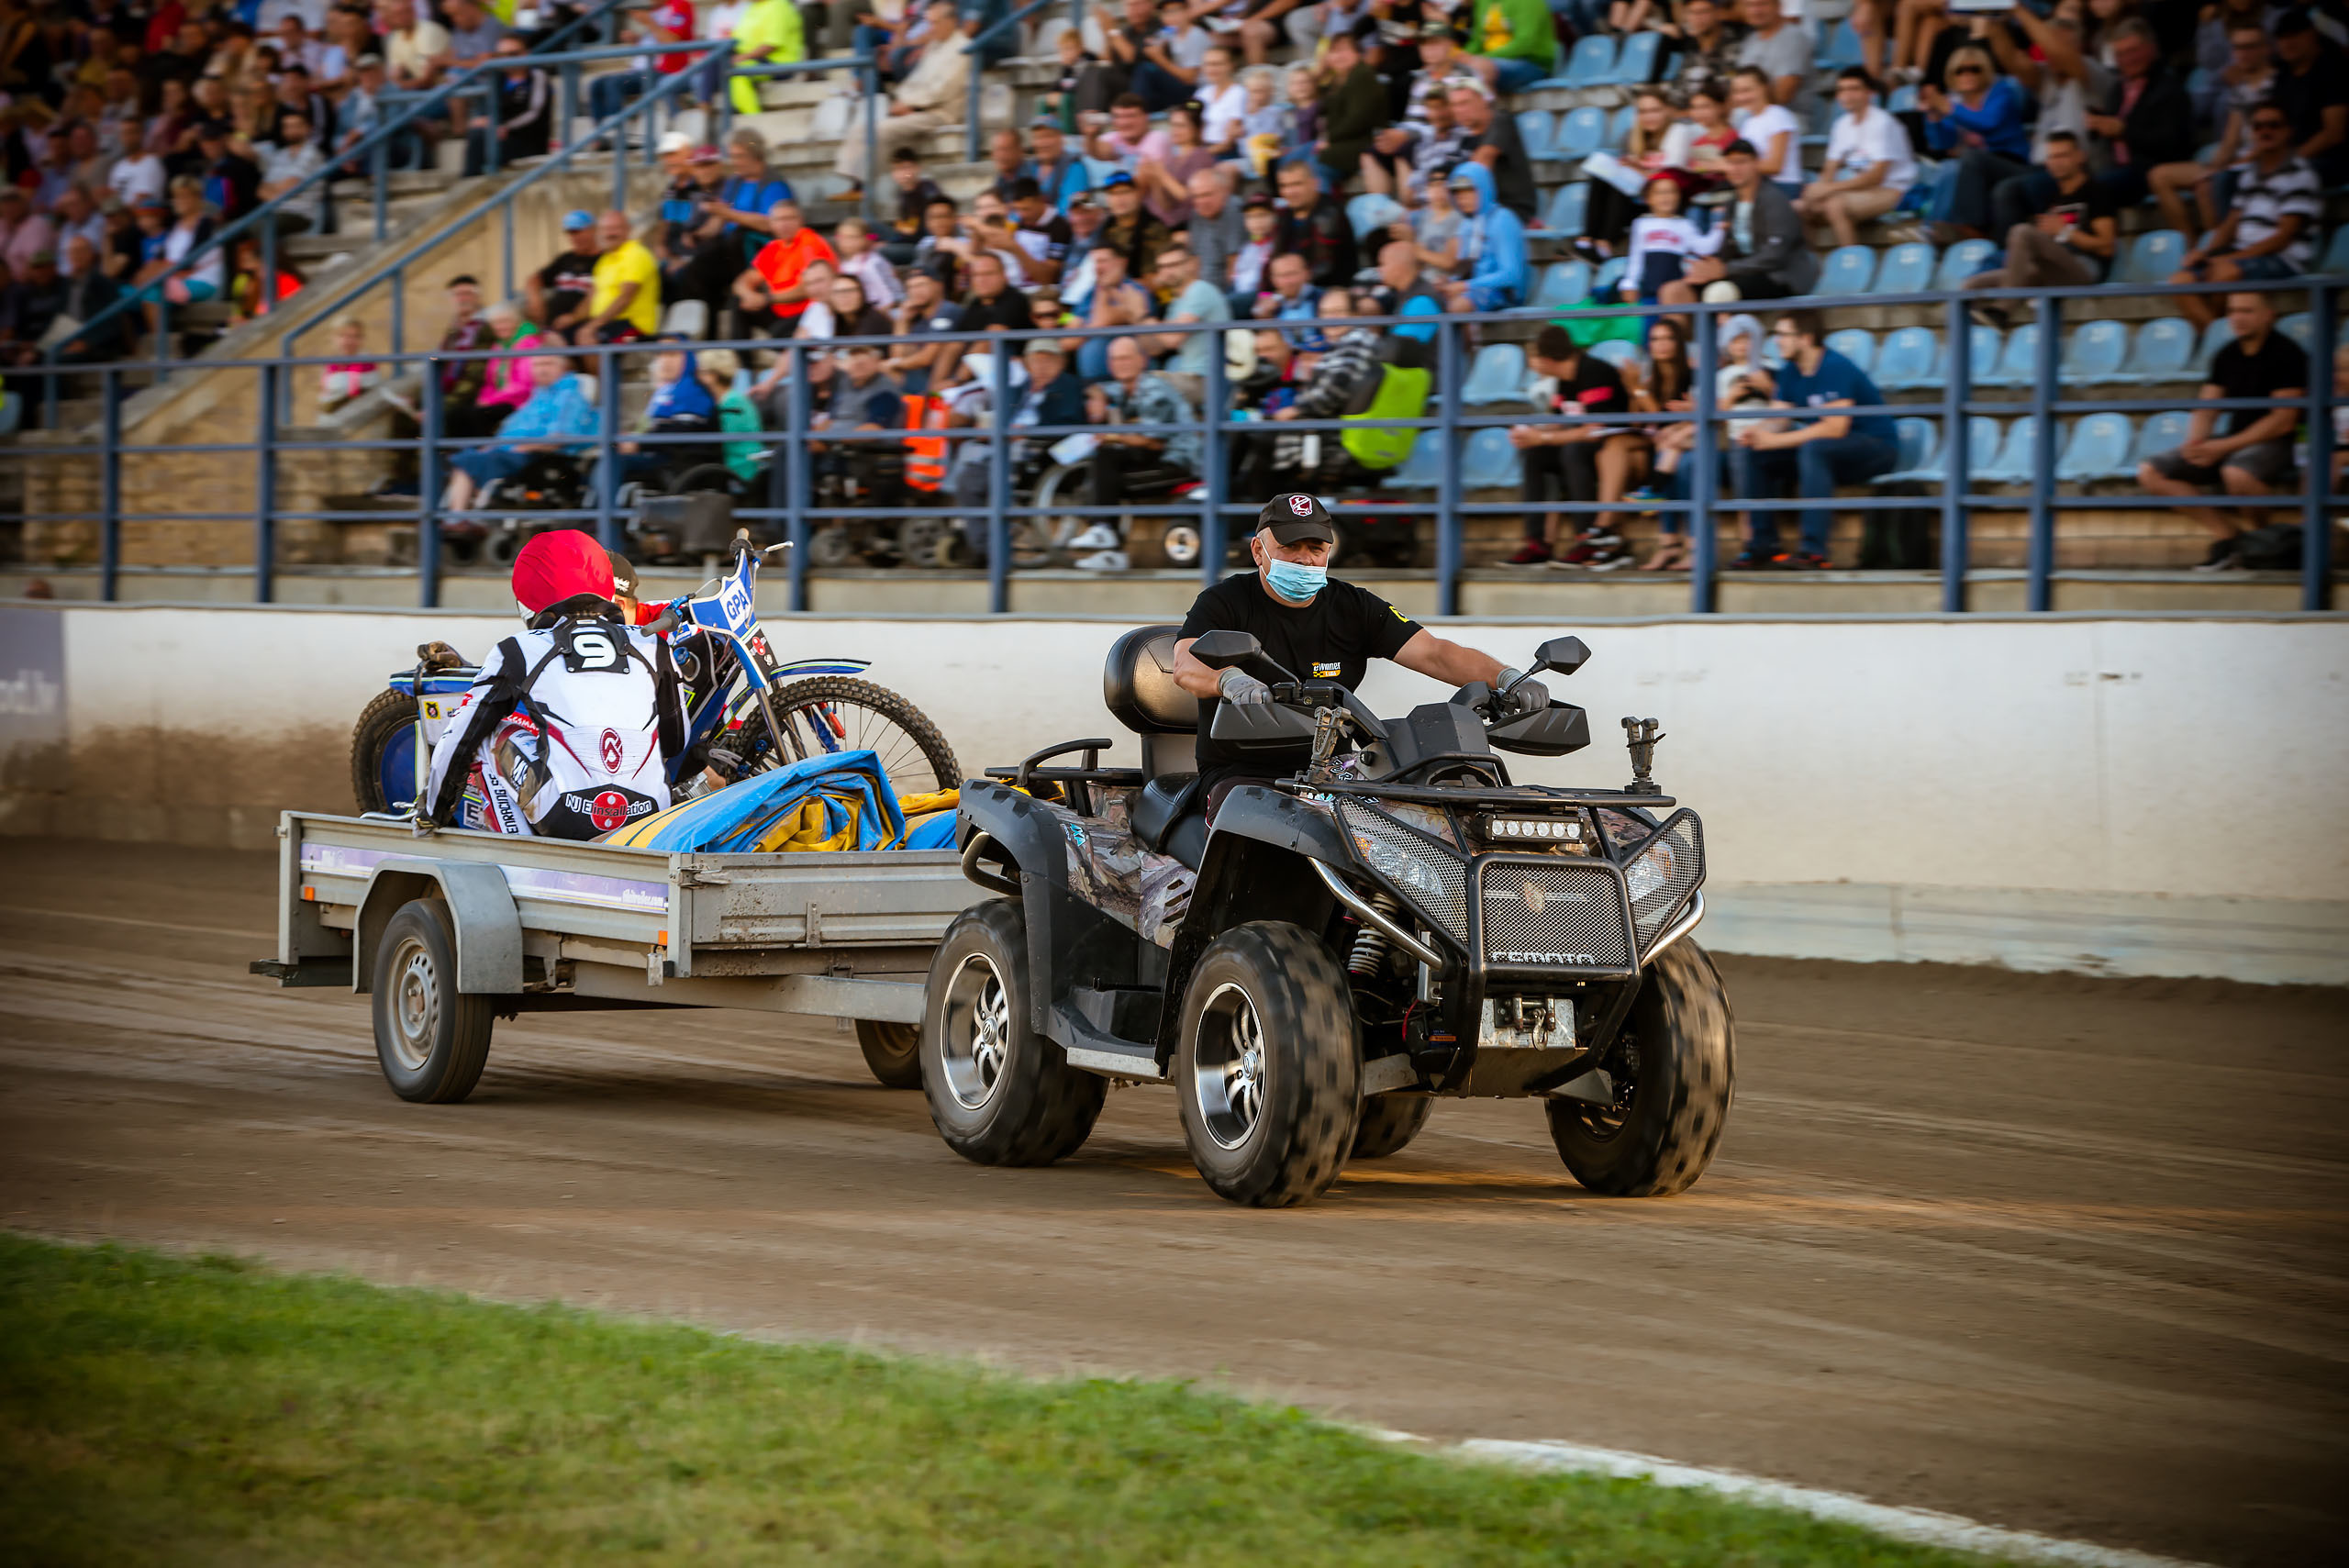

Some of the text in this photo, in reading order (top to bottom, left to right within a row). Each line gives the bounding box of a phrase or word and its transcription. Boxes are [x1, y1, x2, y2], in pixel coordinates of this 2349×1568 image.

[726, 589, 749, 620] GPA
[573, 633, 617, 669] 9
[565, 794, 582, 813] NJ
